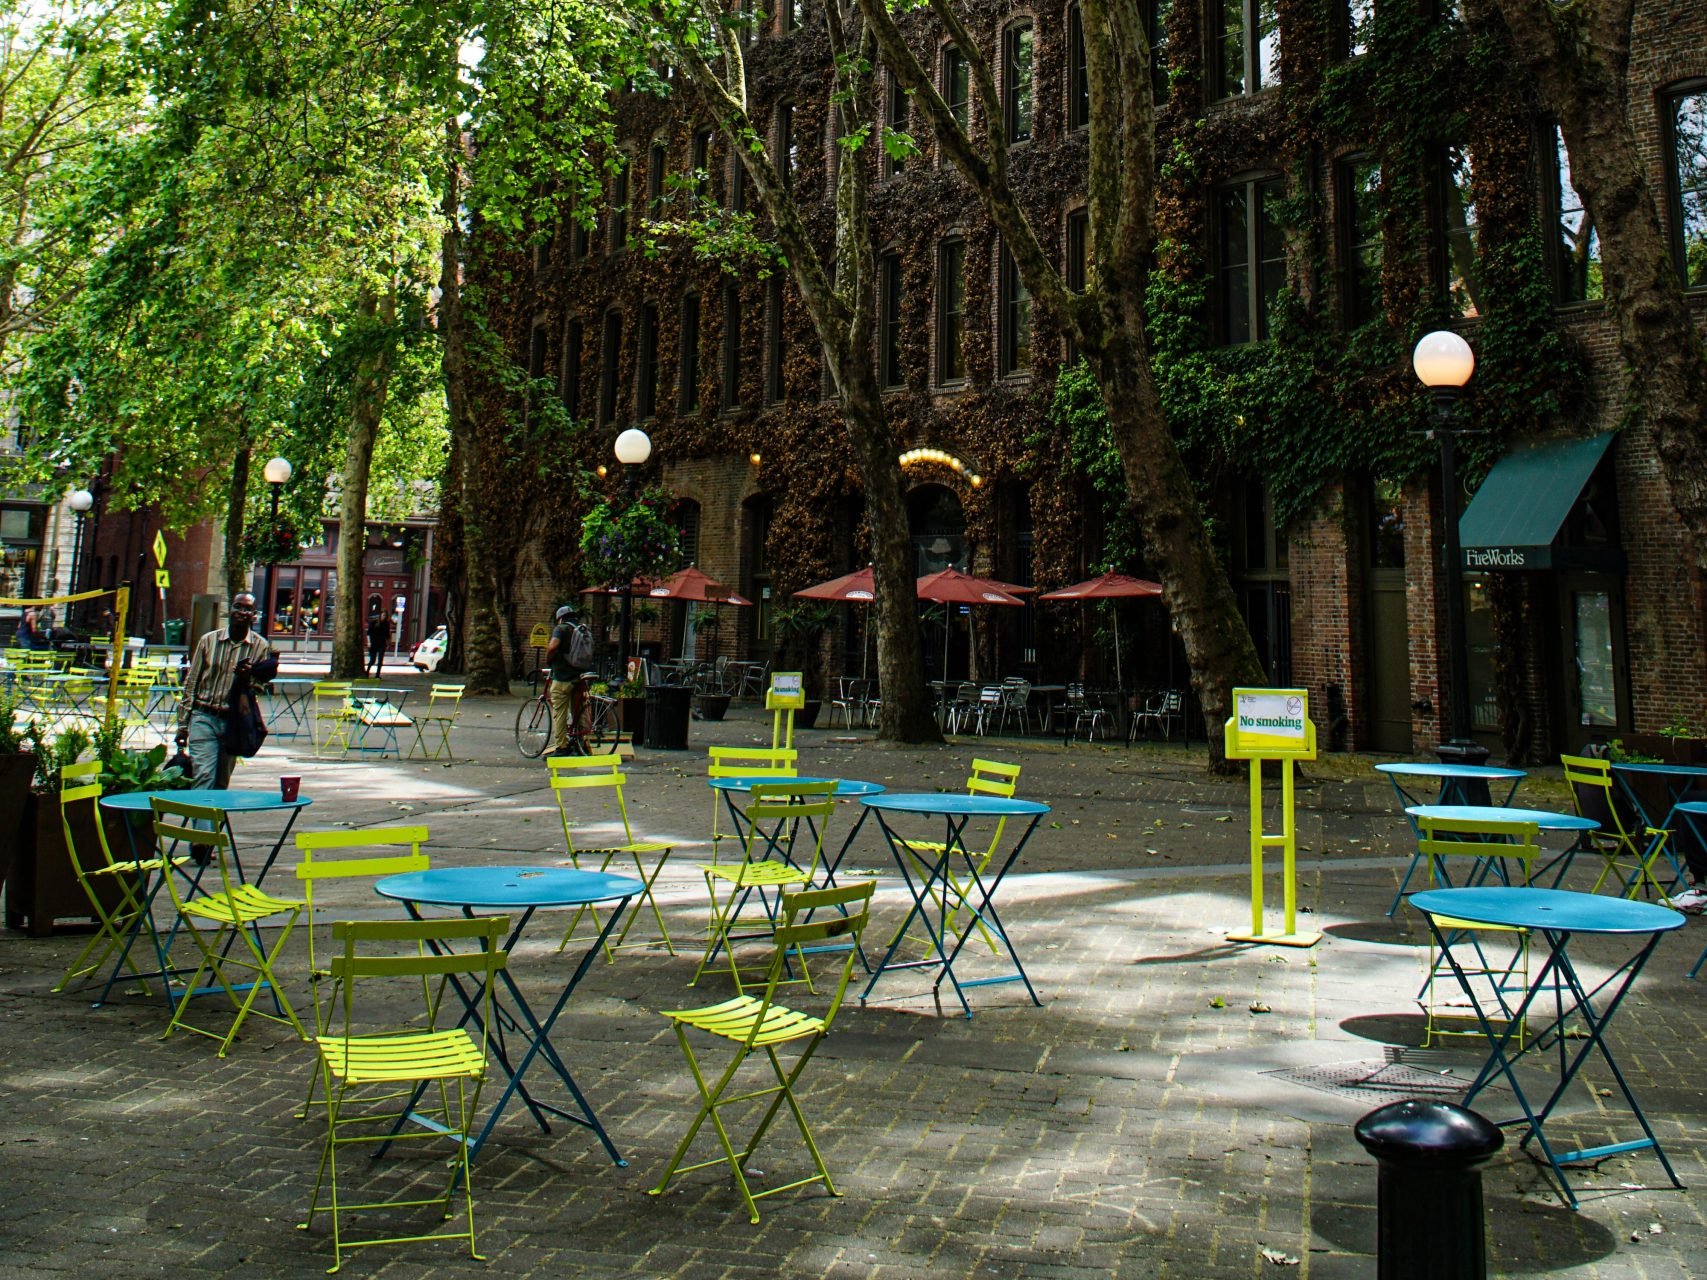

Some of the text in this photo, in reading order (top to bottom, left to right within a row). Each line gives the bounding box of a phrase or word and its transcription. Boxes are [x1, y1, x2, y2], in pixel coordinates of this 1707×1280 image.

[1466, 549, 1525, 565] FireWorks
[1240, 716, 1302, 730] No smoking
